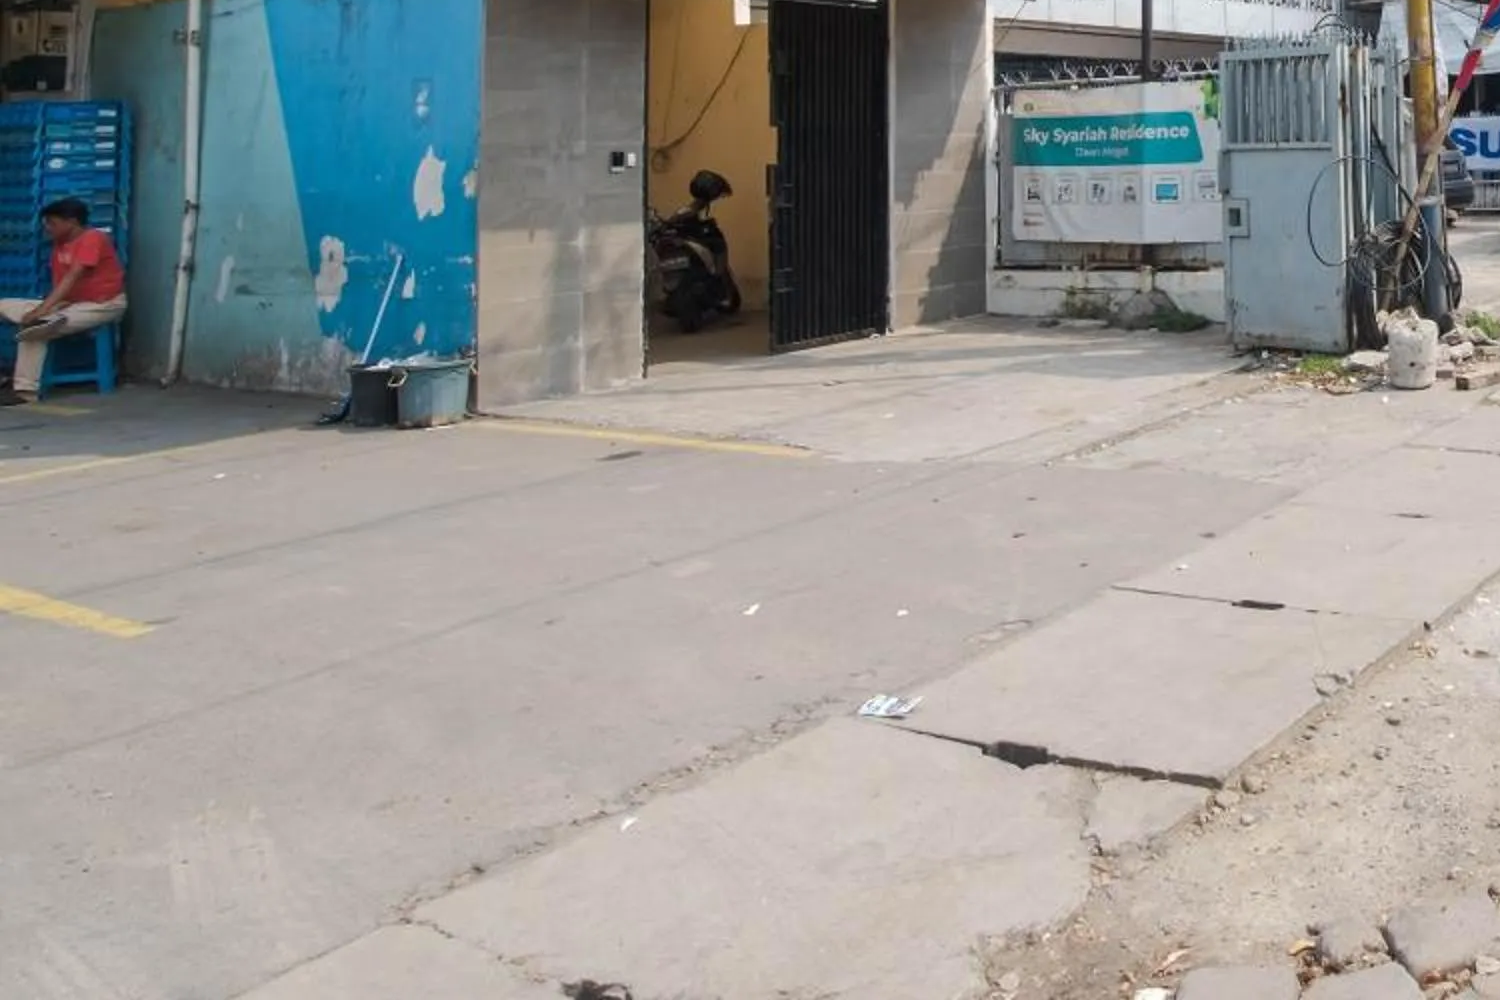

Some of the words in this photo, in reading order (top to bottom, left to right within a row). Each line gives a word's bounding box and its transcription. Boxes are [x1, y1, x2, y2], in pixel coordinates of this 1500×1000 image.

[1023, 128, 1049, 146] Sky
[1053, 125, 1107, 145] Syariah
[1110, 122, 1190, 142] Residence
